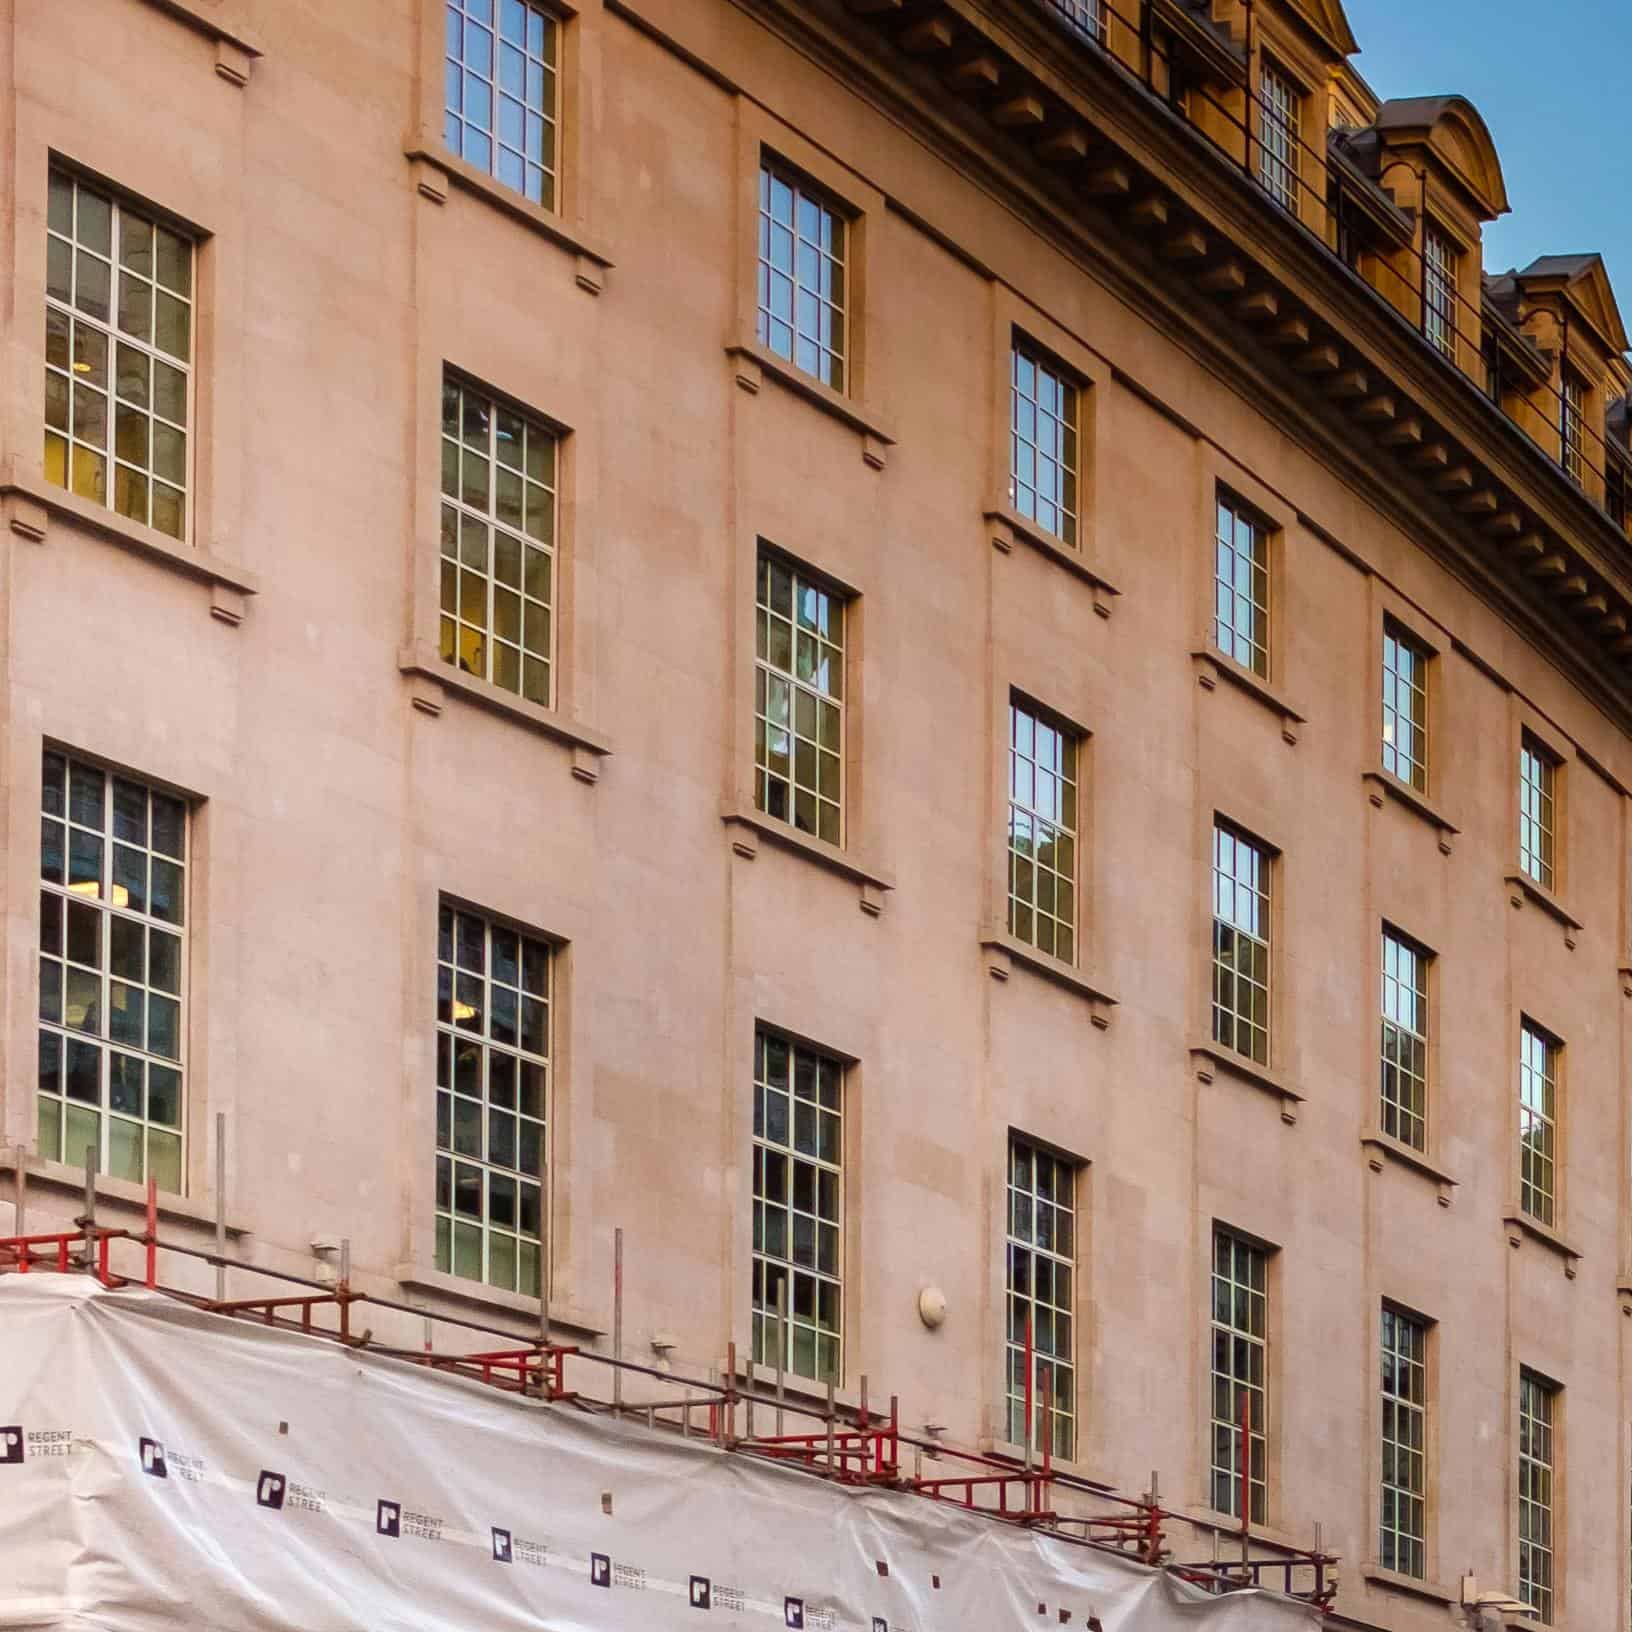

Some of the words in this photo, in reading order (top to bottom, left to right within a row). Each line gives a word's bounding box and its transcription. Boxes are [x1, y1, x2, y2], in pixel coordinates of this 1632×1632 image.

[28, 1431, 72, 1443] REGENT
[29, 1444, 72, 1457] STREET
[403, 1511, 444, 1529] REGENT
[402, 1524, 442, 1540] STREET
